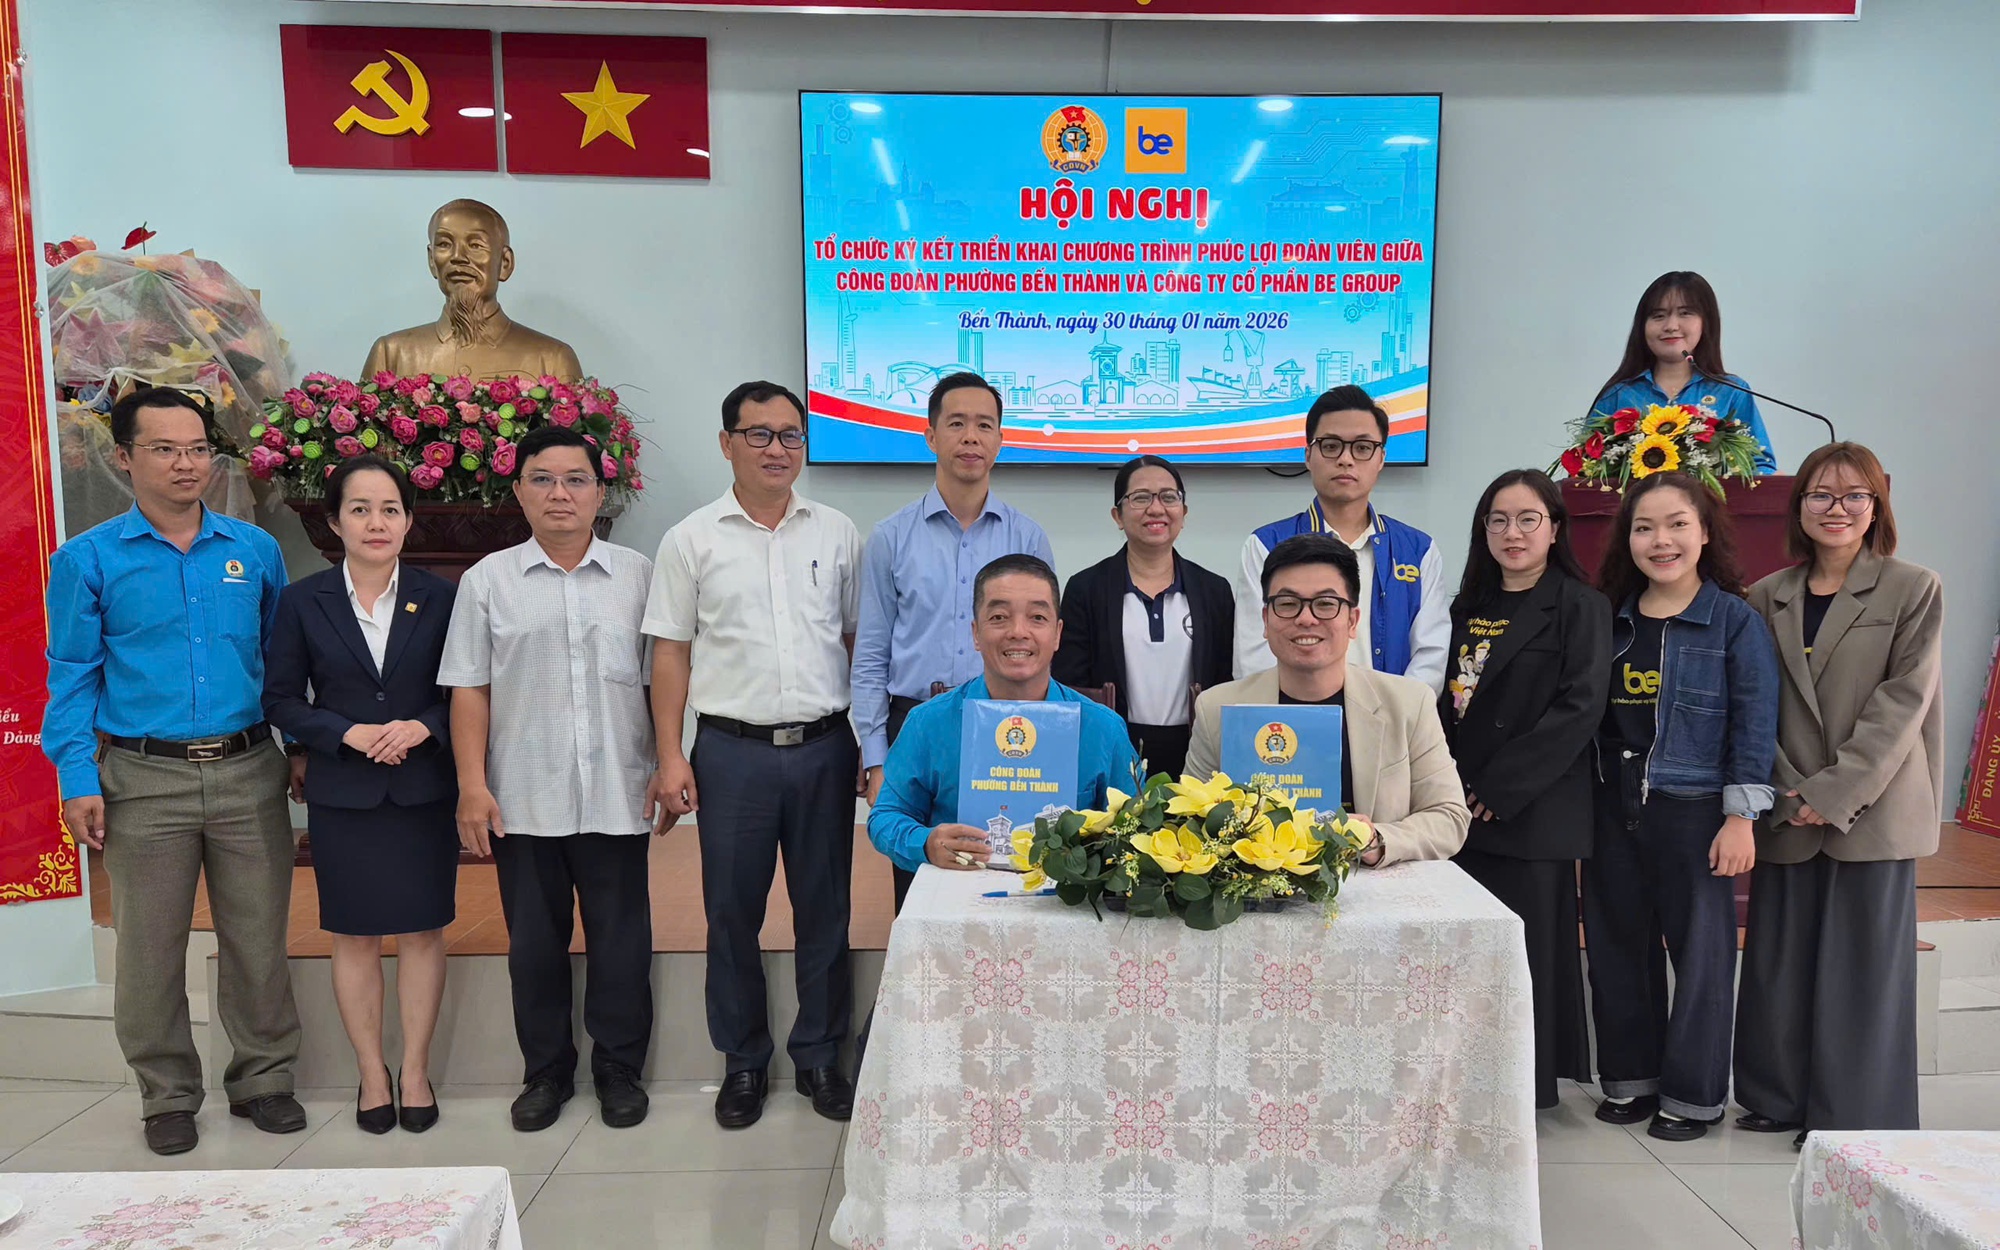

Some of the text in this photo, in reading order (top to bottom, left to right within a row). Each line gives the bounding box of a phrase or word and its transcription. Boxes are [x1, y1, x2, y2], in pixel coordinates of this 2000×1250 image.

[1137, 125, 1174, 155] be
[1020, 177, 1210, 230] HỘI NGHỊ
[814, 233, 1423, 266] TỔ CHỨC KÝ KẾT TRIỂN KHAI CHƯƠNG TRÌNH PHÚC LỢI ĐOÀN VIÊN GIỮA
[836, 266, 1401, 293] CÔNG ĐOÀN PHƯỜNG BẾN THÀNH VÀ CÔNG TY CỔ PHẦN BE GROUP
[958, 308, 1289, 333] Bến Thành, ngày 30 tháng 01 năm 2026
[1623, 662, 1660, 695] be
[3, 730, 42, 746] Đảng
[990, 765, 1014, 778] CÔNG
